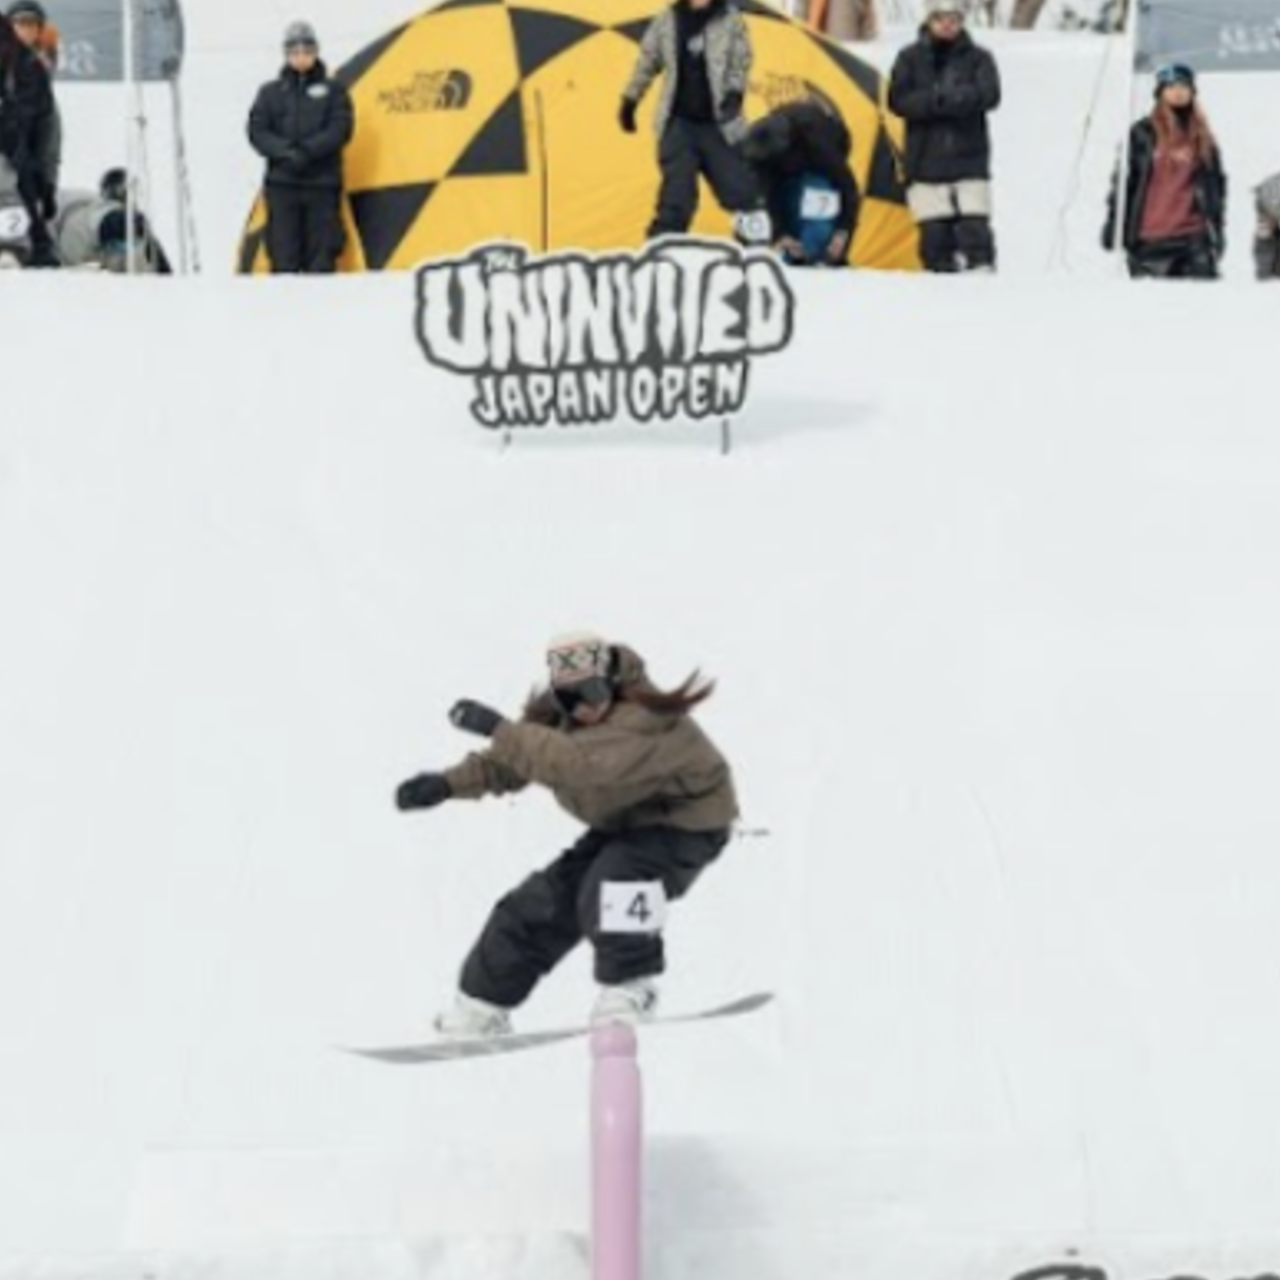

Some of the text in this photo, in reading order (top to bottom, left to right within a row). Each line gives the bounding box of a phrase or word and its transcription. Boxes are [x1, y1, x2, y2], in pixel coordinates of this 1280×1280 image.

[418, 240, 790, 373] UNINVITED
[473, 360, 745, 425] JAPAN OPEN
[626, 891, 652, 925] 4
